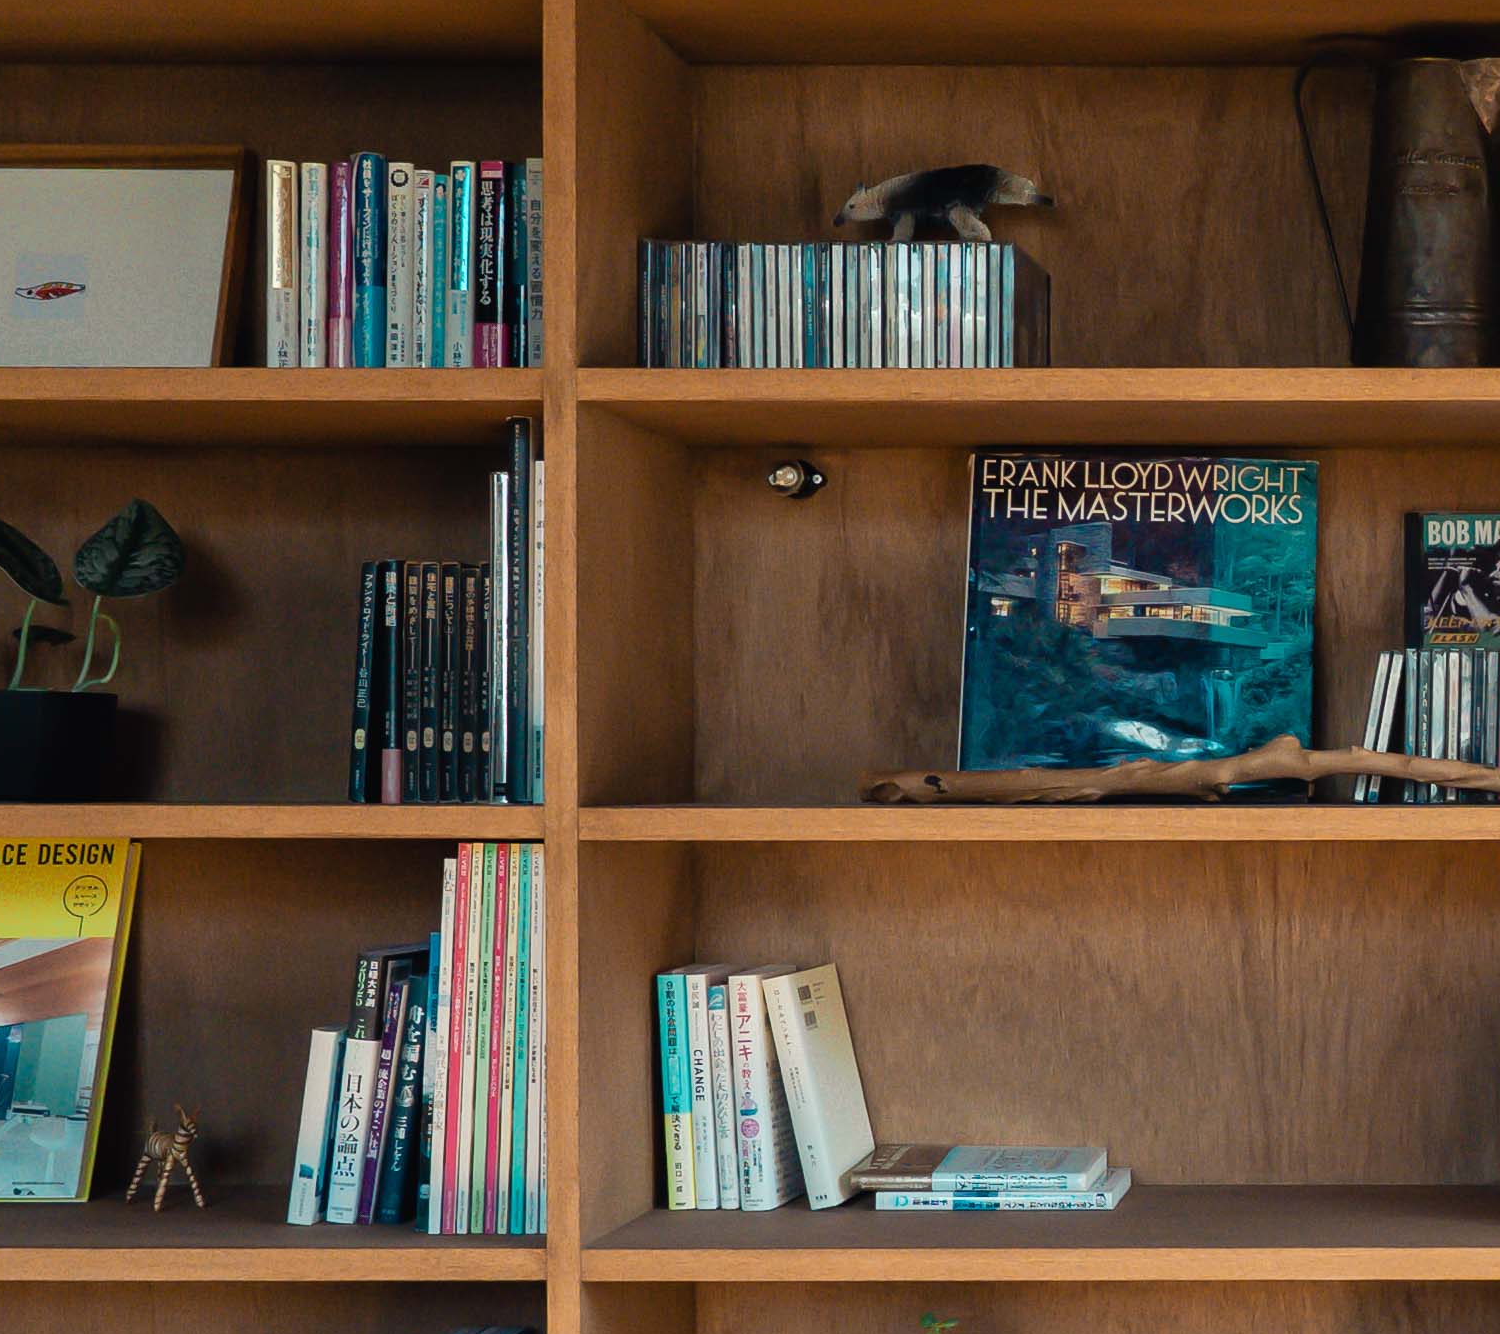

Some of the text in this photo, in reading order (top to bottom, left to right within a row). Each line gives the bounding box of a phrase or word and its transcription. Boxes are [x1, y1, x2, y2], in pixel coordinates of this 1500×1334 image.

[479, 180, 496, 306] 思考は現実化する
[982, 459, 1306, 494] FRANK LLOYD WRIGHT
[982, 488, 1303, 524] THE MASTERWORKS
[1427, 519, 1471, 546] BOB
[37, 843, 115, 866] DESIGN
[354, 959, 368, 1007] 2025
[735, 981, 753, 1094] 大富豪アニキの教え
[693, 1049, 706, 1102] CHANGE
[333, 1072, 364, 1177] 日本の論点
